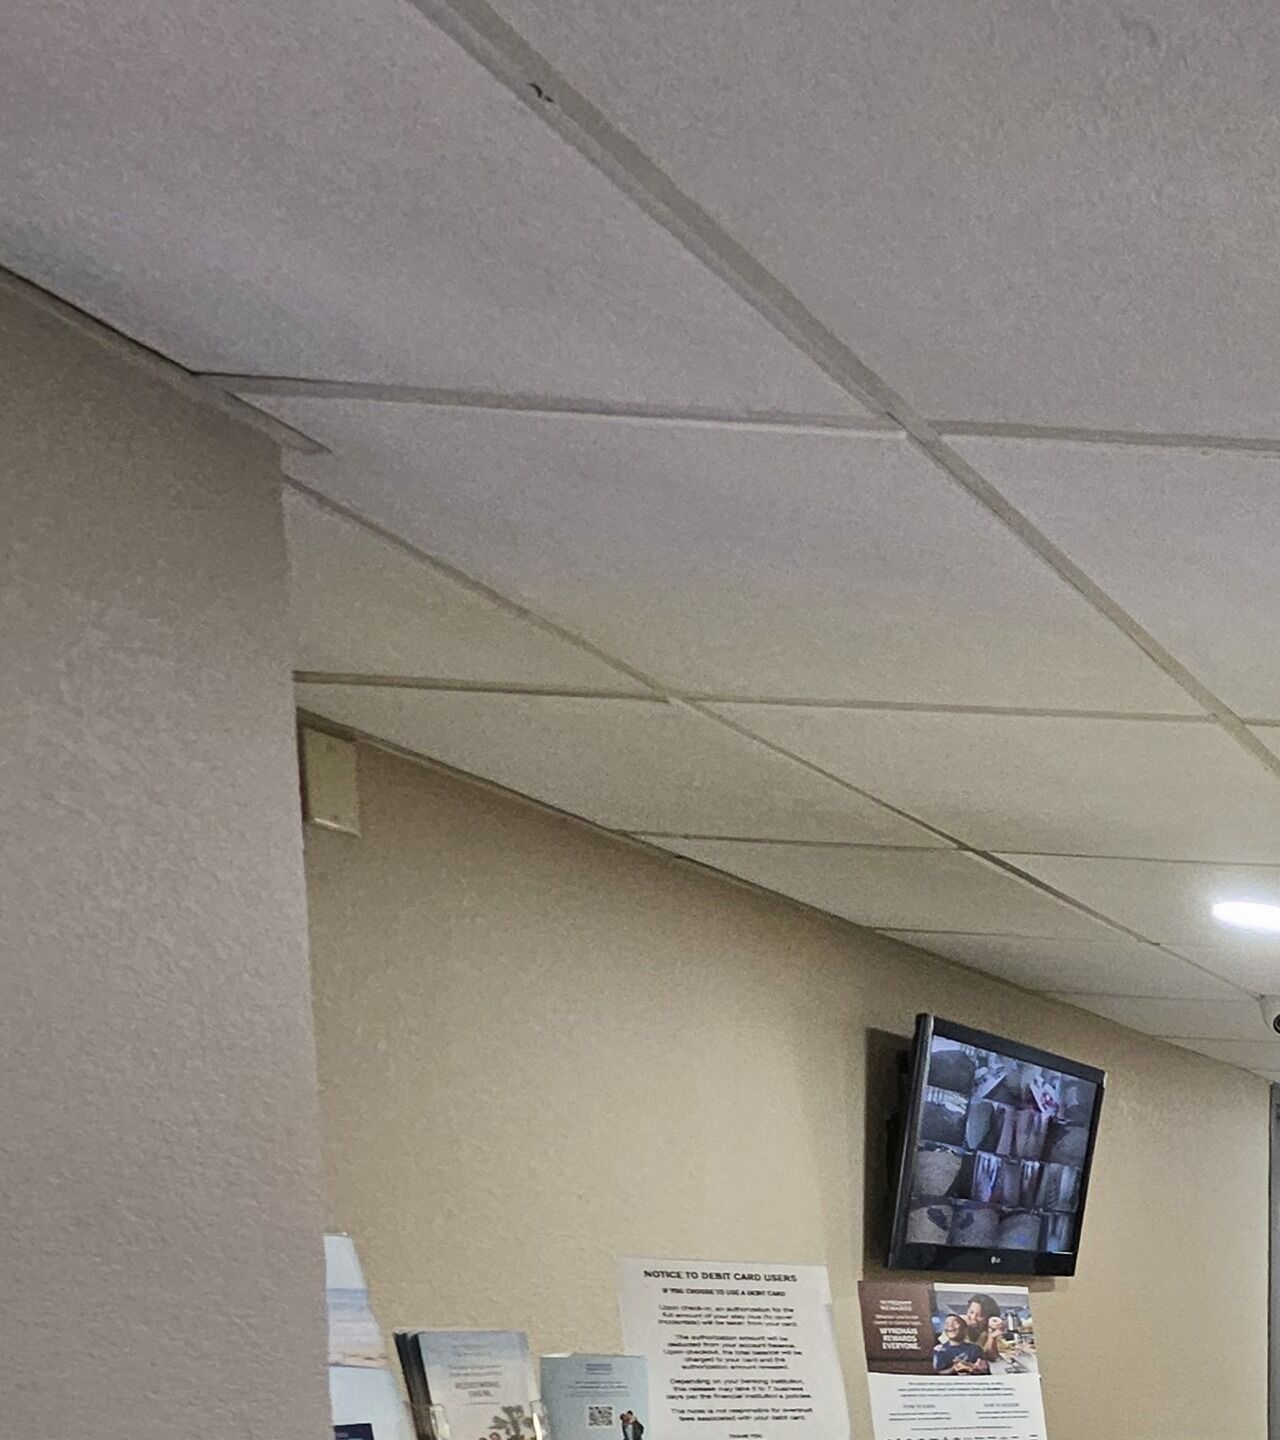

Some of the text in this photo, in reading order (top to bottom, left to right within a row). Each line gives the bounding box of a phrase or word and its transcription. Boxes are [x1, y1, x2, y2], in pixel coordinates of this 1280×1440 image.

[643, 1270, 682, 1279] NOTICE
[701, 1272, 731, 1280] DEBIT
[733, 1273, 761, 1281] CARD
[763, 1274, 797, 1282] USERS
